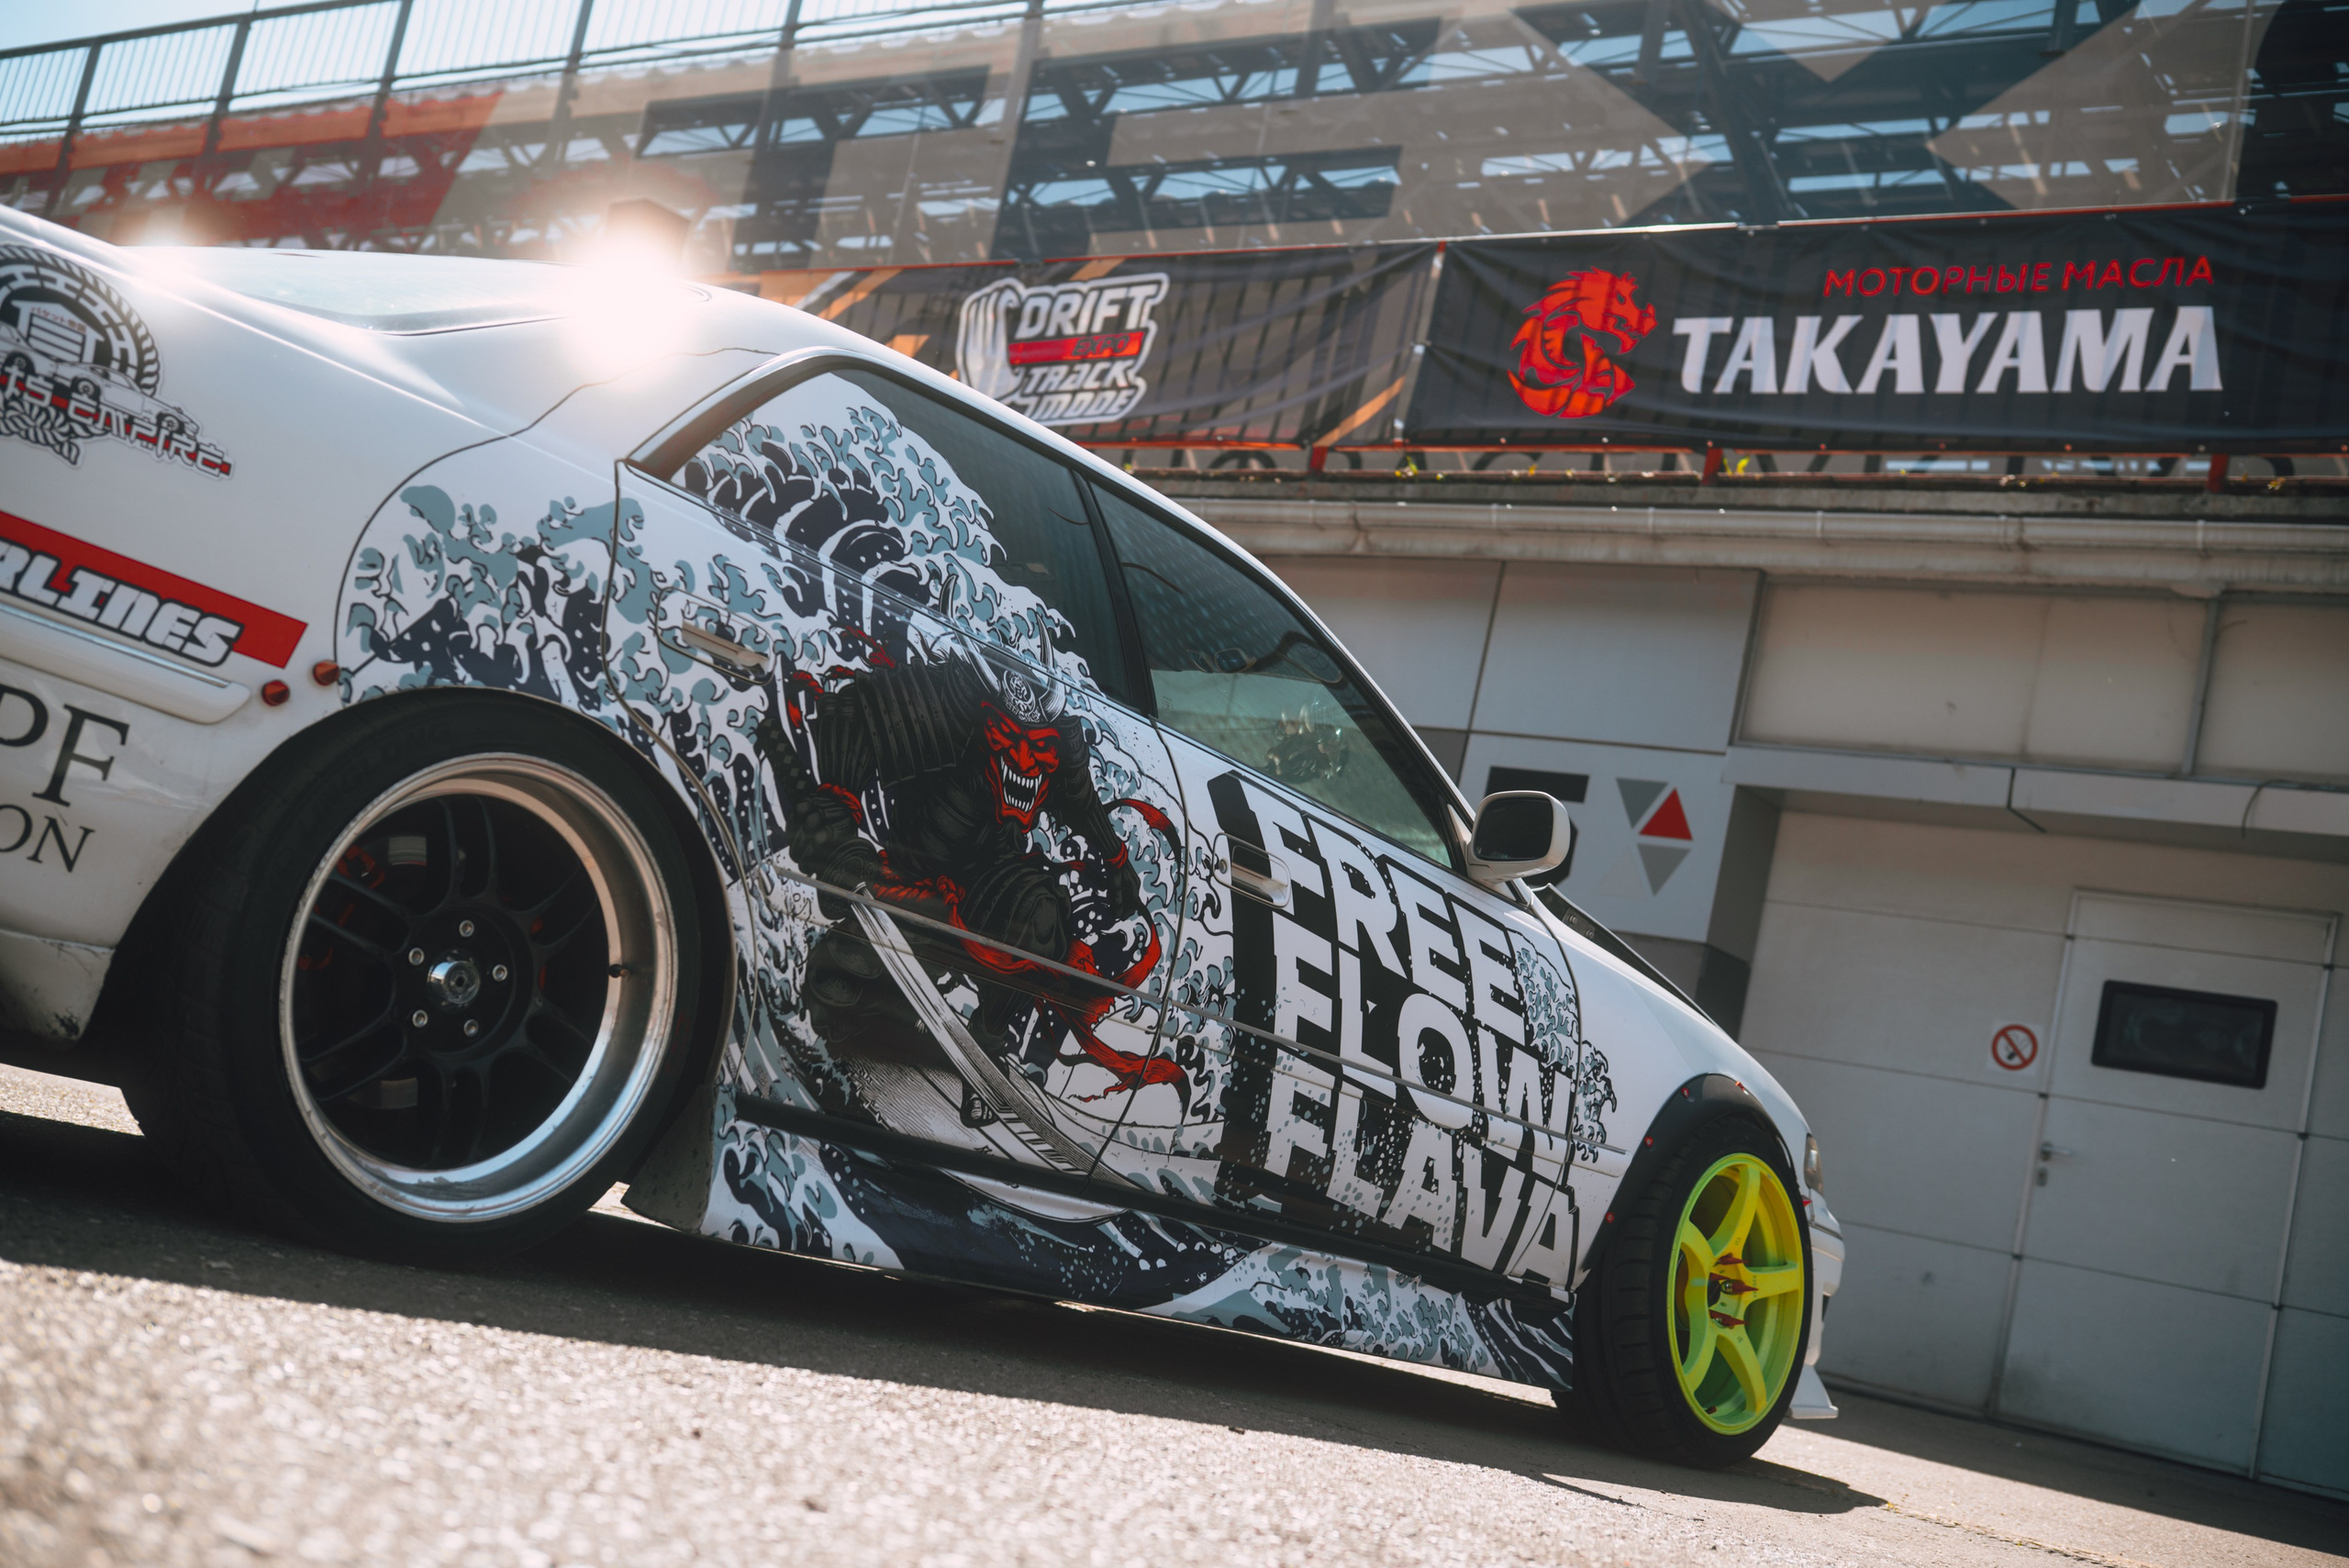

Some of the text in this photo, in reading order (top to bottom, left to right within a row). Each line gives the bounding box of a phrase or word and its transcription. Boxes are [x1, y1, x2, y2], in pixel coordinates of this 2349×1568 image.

[1015, 284, 1158, 339] DRIFT
[1823, 255, 2214, 297] МОТОРНЫЕ МАСЛА
[1073, 335, 1130, 355] EXPO
[1673, 306, 2223, 394] TAKAYAMA
[1248, 771, 1529, 1046] FREE
[1272, 912, 1574, 1184] FLOW
[1263, 1049, 1578, 1299] FLAVA
